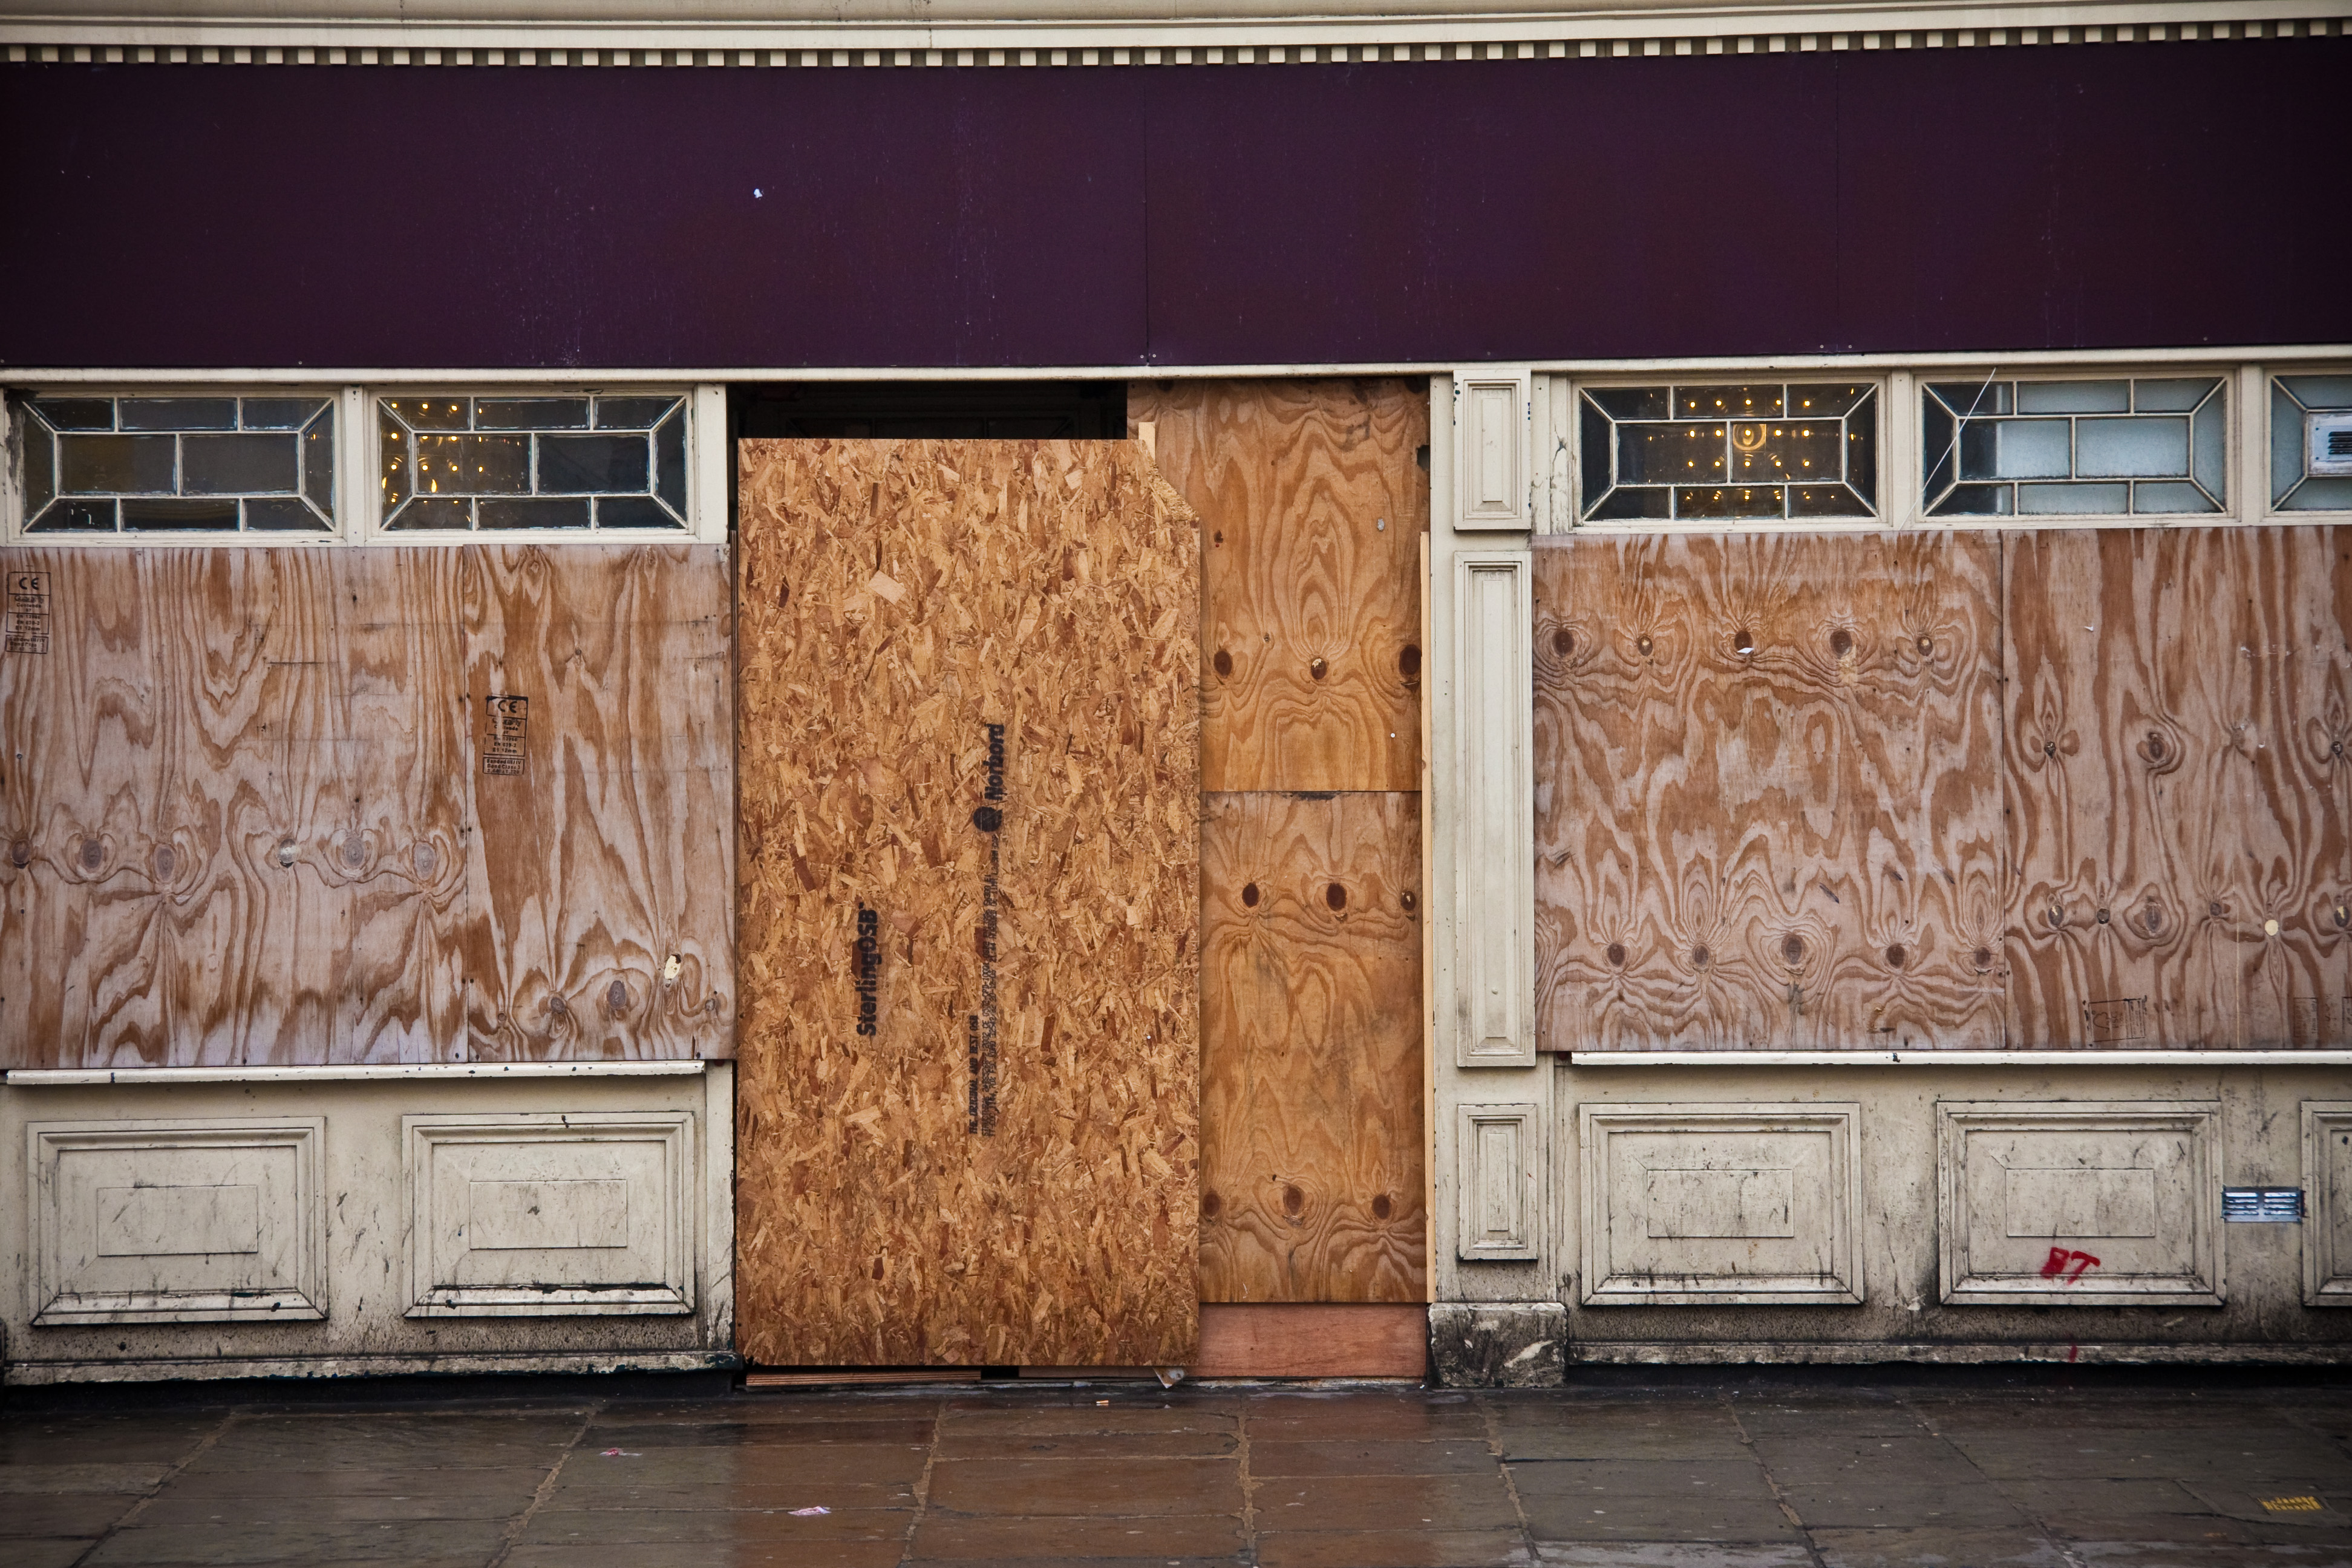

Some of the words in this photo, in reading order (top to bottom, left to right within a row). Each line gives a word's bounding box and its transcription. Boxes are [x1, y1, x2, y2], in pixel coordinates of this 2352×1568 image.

[19, 577, 39, 590] CE
[498, 699, 517, 713] CE
[984, 723, 1005, 800] Norbord
[855, 909, 883, 1036] SterlingOSB
[969, 1015, 978, 1031] OSB
[970, 1034, 978, 1054] BEST
[969, 1057, 978, 1075] AND
[969, 1078, 978, 1116] ORIGINAL
[969, 1119, 978, 1134] THE
